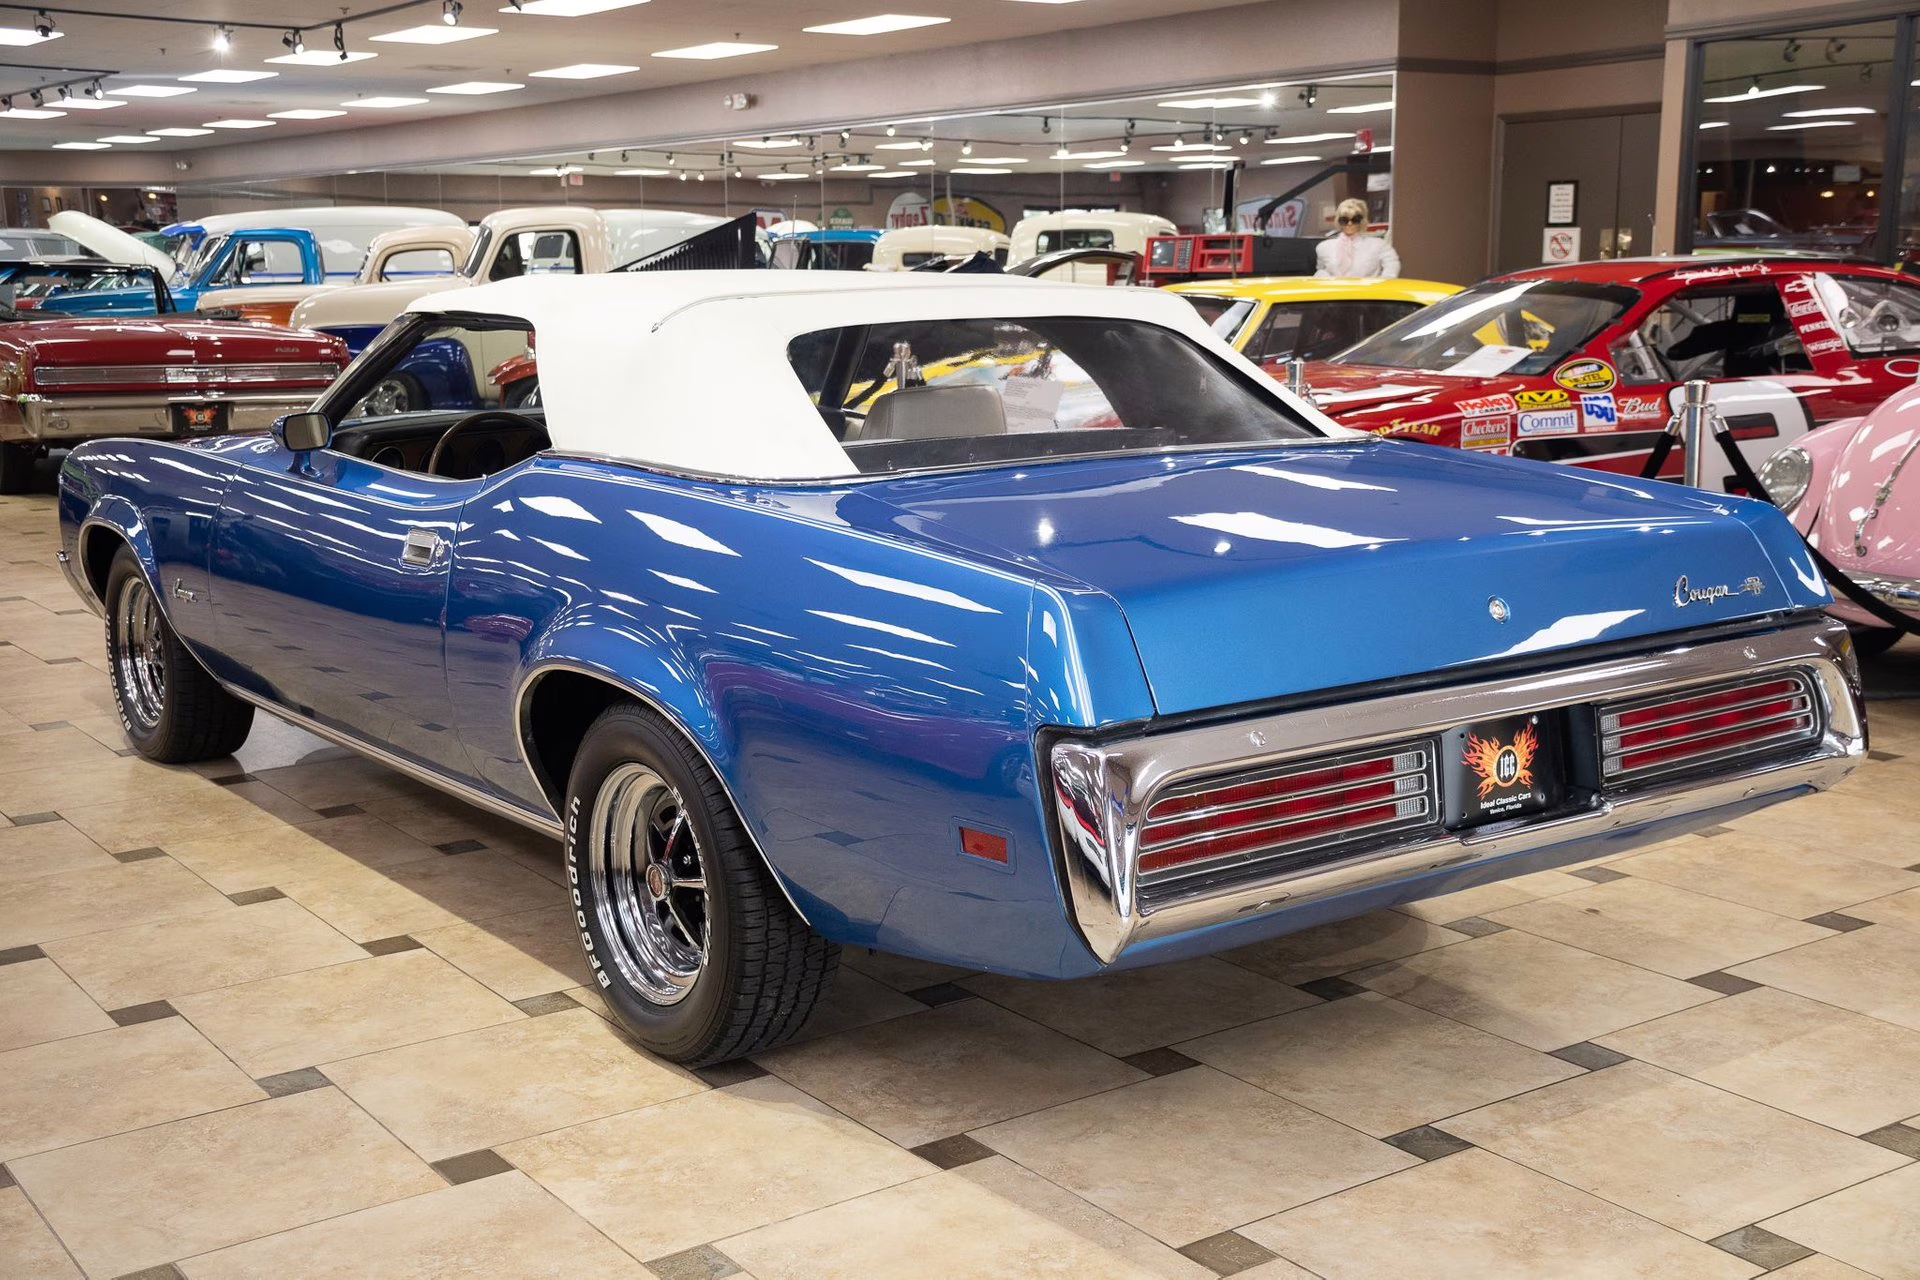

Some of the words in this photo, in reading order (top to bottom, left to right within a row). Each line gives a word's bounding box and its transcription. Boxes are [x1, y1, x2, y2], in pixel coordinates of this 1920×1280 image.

[1461, 397, 1514, 410] Holley
[1617, 397, 1662, 415] Bud
[1464, 420, 1508, 436] Checkers
[1520, 411, 1575, 433] Commit
[1674, 574, 1740, 607] Cougar
[1480, 800, 1496, 810] Ideal
[1495, 794, 1517, 806] Classic
[1517, 792, 1532, 801] Cars
[1505, 803, 1522, 811] Florida
[567, 796, 612, 989] BFGoodrich
